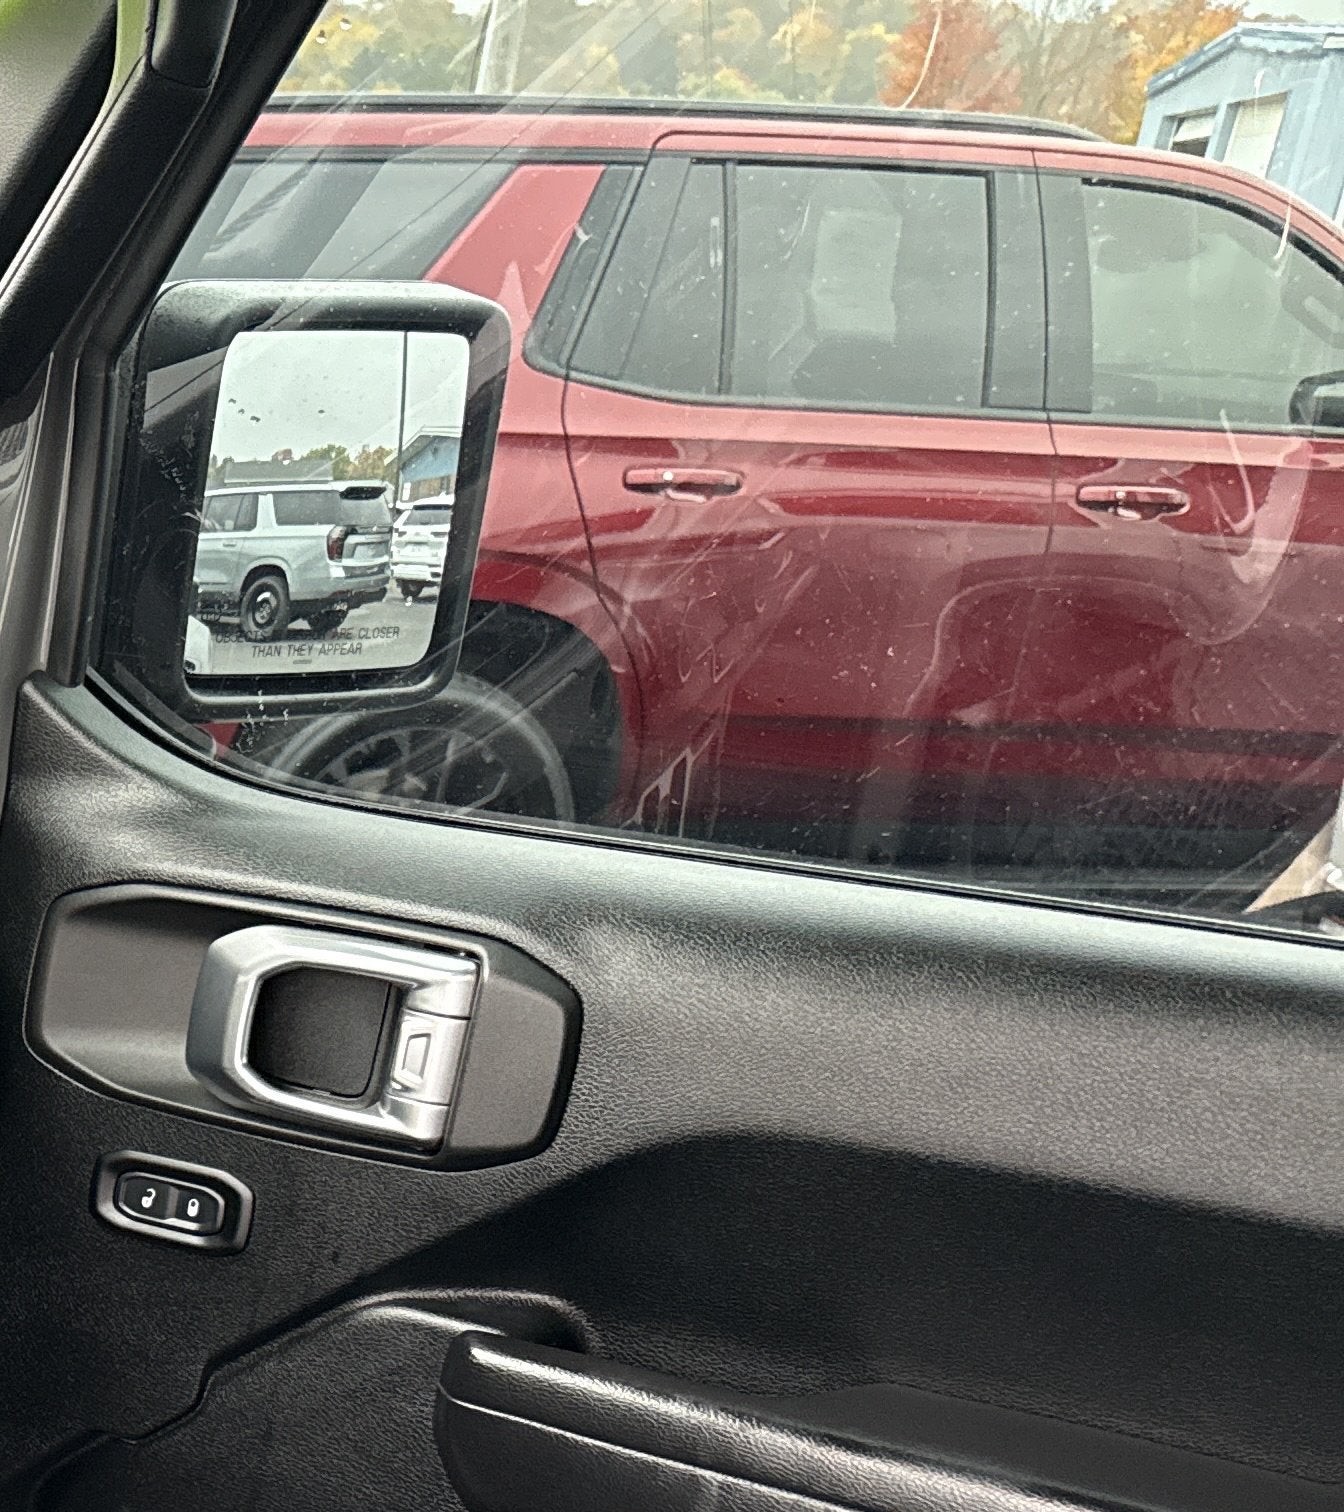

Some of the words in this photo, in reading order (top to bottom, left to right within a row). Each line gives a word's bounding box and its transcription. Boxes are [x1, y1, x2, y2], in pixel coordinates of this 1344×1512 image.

[358, 626, 400, 640] CLOSER
[252, 645, 281, 658] THAN
[287, 644, 315, 657] THEY
[318, 642, 363, 656] APPEAR
